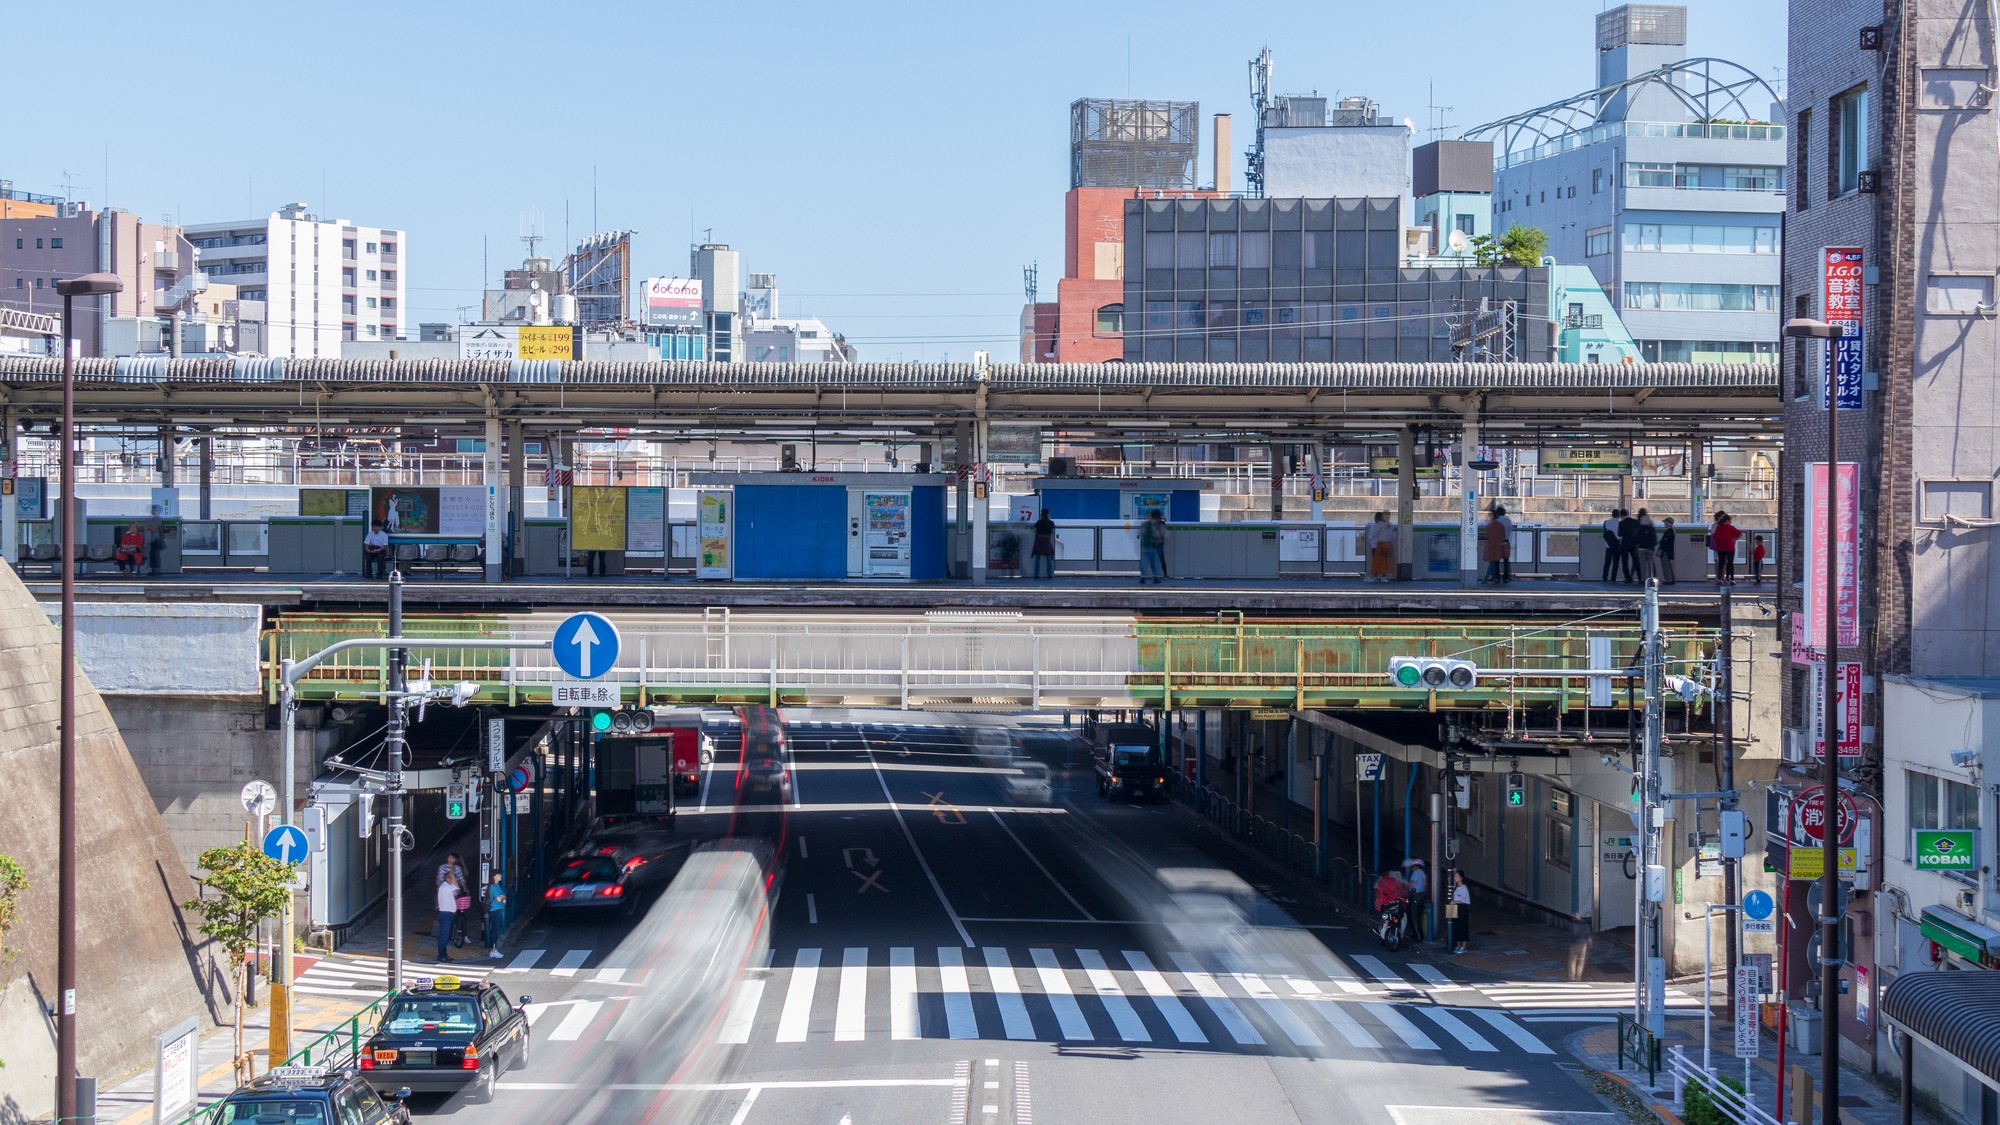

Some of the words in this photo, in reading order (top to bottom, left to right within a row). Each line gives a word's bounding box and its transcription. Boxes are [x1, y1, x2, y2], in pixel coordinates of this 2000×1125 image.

[1826, 265, 1863, 277] I.G.O
[653, 283, 698, 295] docomo
[1828, 278, 1860, 292] 音楽
[1828, 294, 1860, 309] 教室
[553, 333, 570, 342] 199
[465, 349, 513, 359] ミライザカ
[521, 345, 546, 354] 生ビール
[552, 345, 570, 354] 299
[1837, 340, 1849, 397] リハーサル
[1849, 340, 1862, 397] 貸スタジオ
[1569, 450, 1601, 459] 西日暮里
[558, 687, 615, 702] 自転車を除く
[1848, 675, 1859, 724] ハート音楽院
[1849, 726, 1858, 743] 2F
[492, 721, 501, 770] スクランブル式
[1361, 755, 1380, 763] TAX
[1604, 837, 1615, 845] JR
[1920, 855, 1971, 865] KOBAN
[1745, 922, 1772, 931] 歩行者優先
[1737, 969, 1747, 1047] ゆっくり通行しましょう
[1748, 969, 1757, 1047] 自転車は車道寄りを
[377, 1052, 395, 1060] IKEDA
